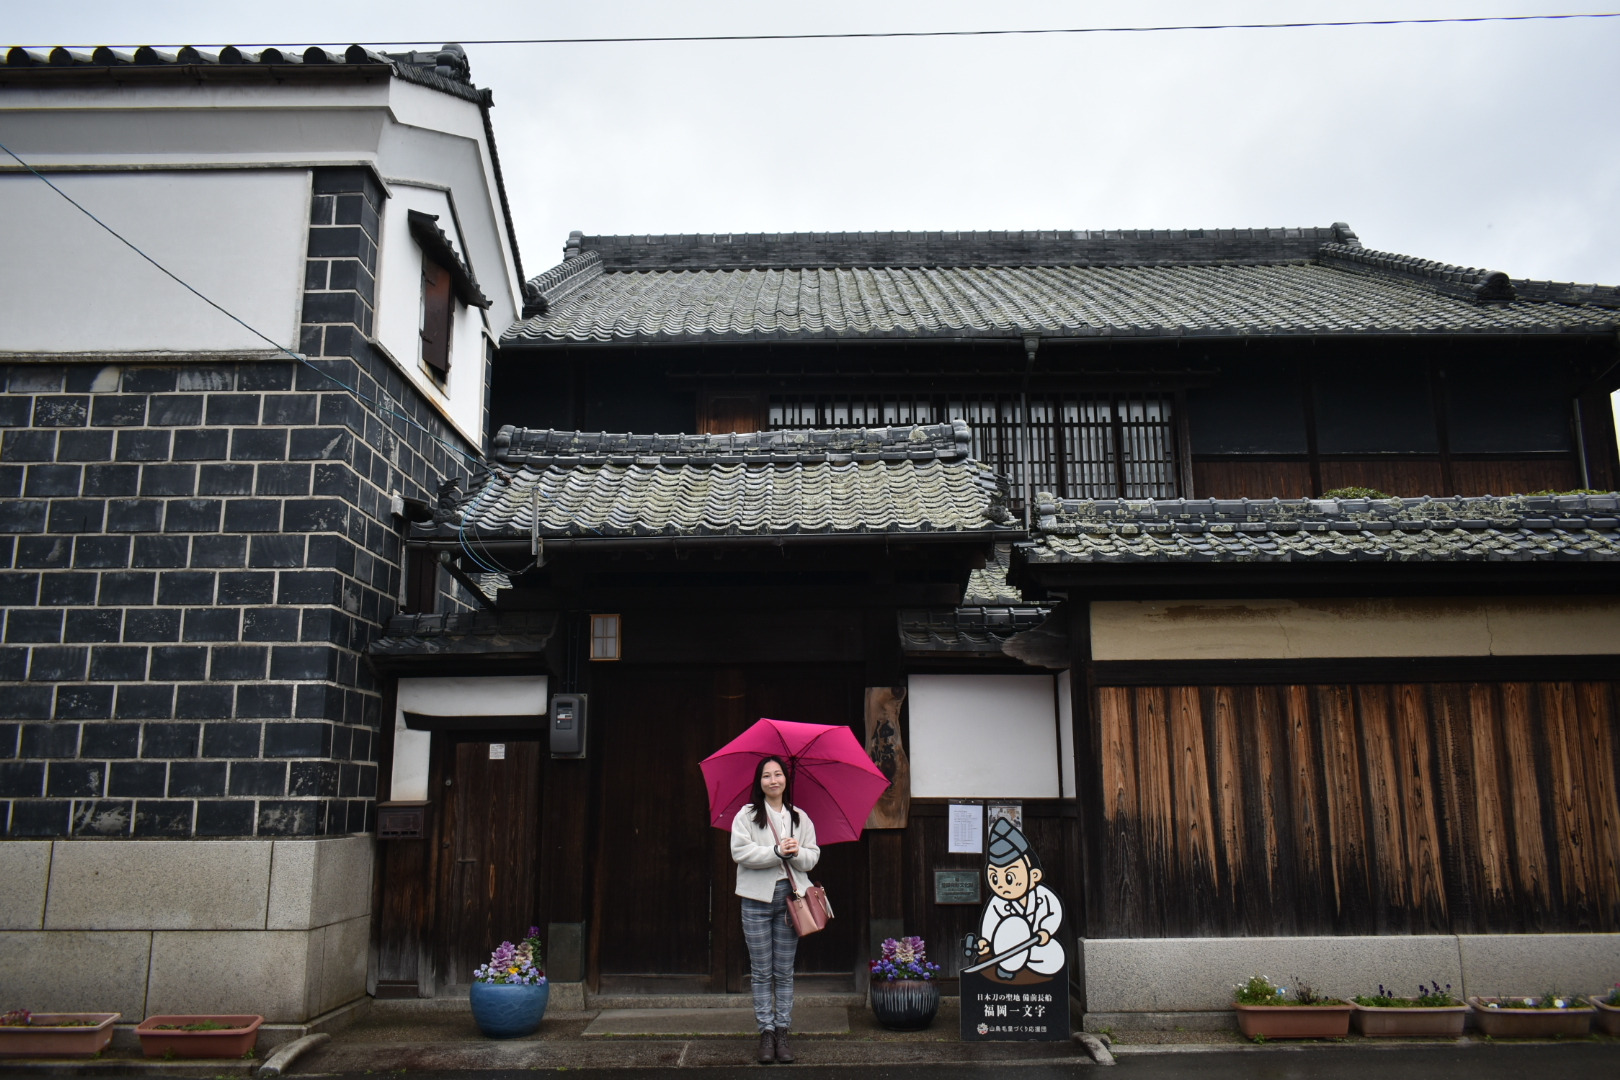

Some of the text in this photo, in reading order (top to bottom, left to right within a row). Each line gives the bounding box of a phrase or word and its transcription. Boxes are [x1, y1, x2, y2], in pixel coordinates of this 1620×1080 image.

[977, 993, 1053, 1002] 日本刀の聖地 備前長船
[984, 1004, 1046, 1018] 福岡一文字
